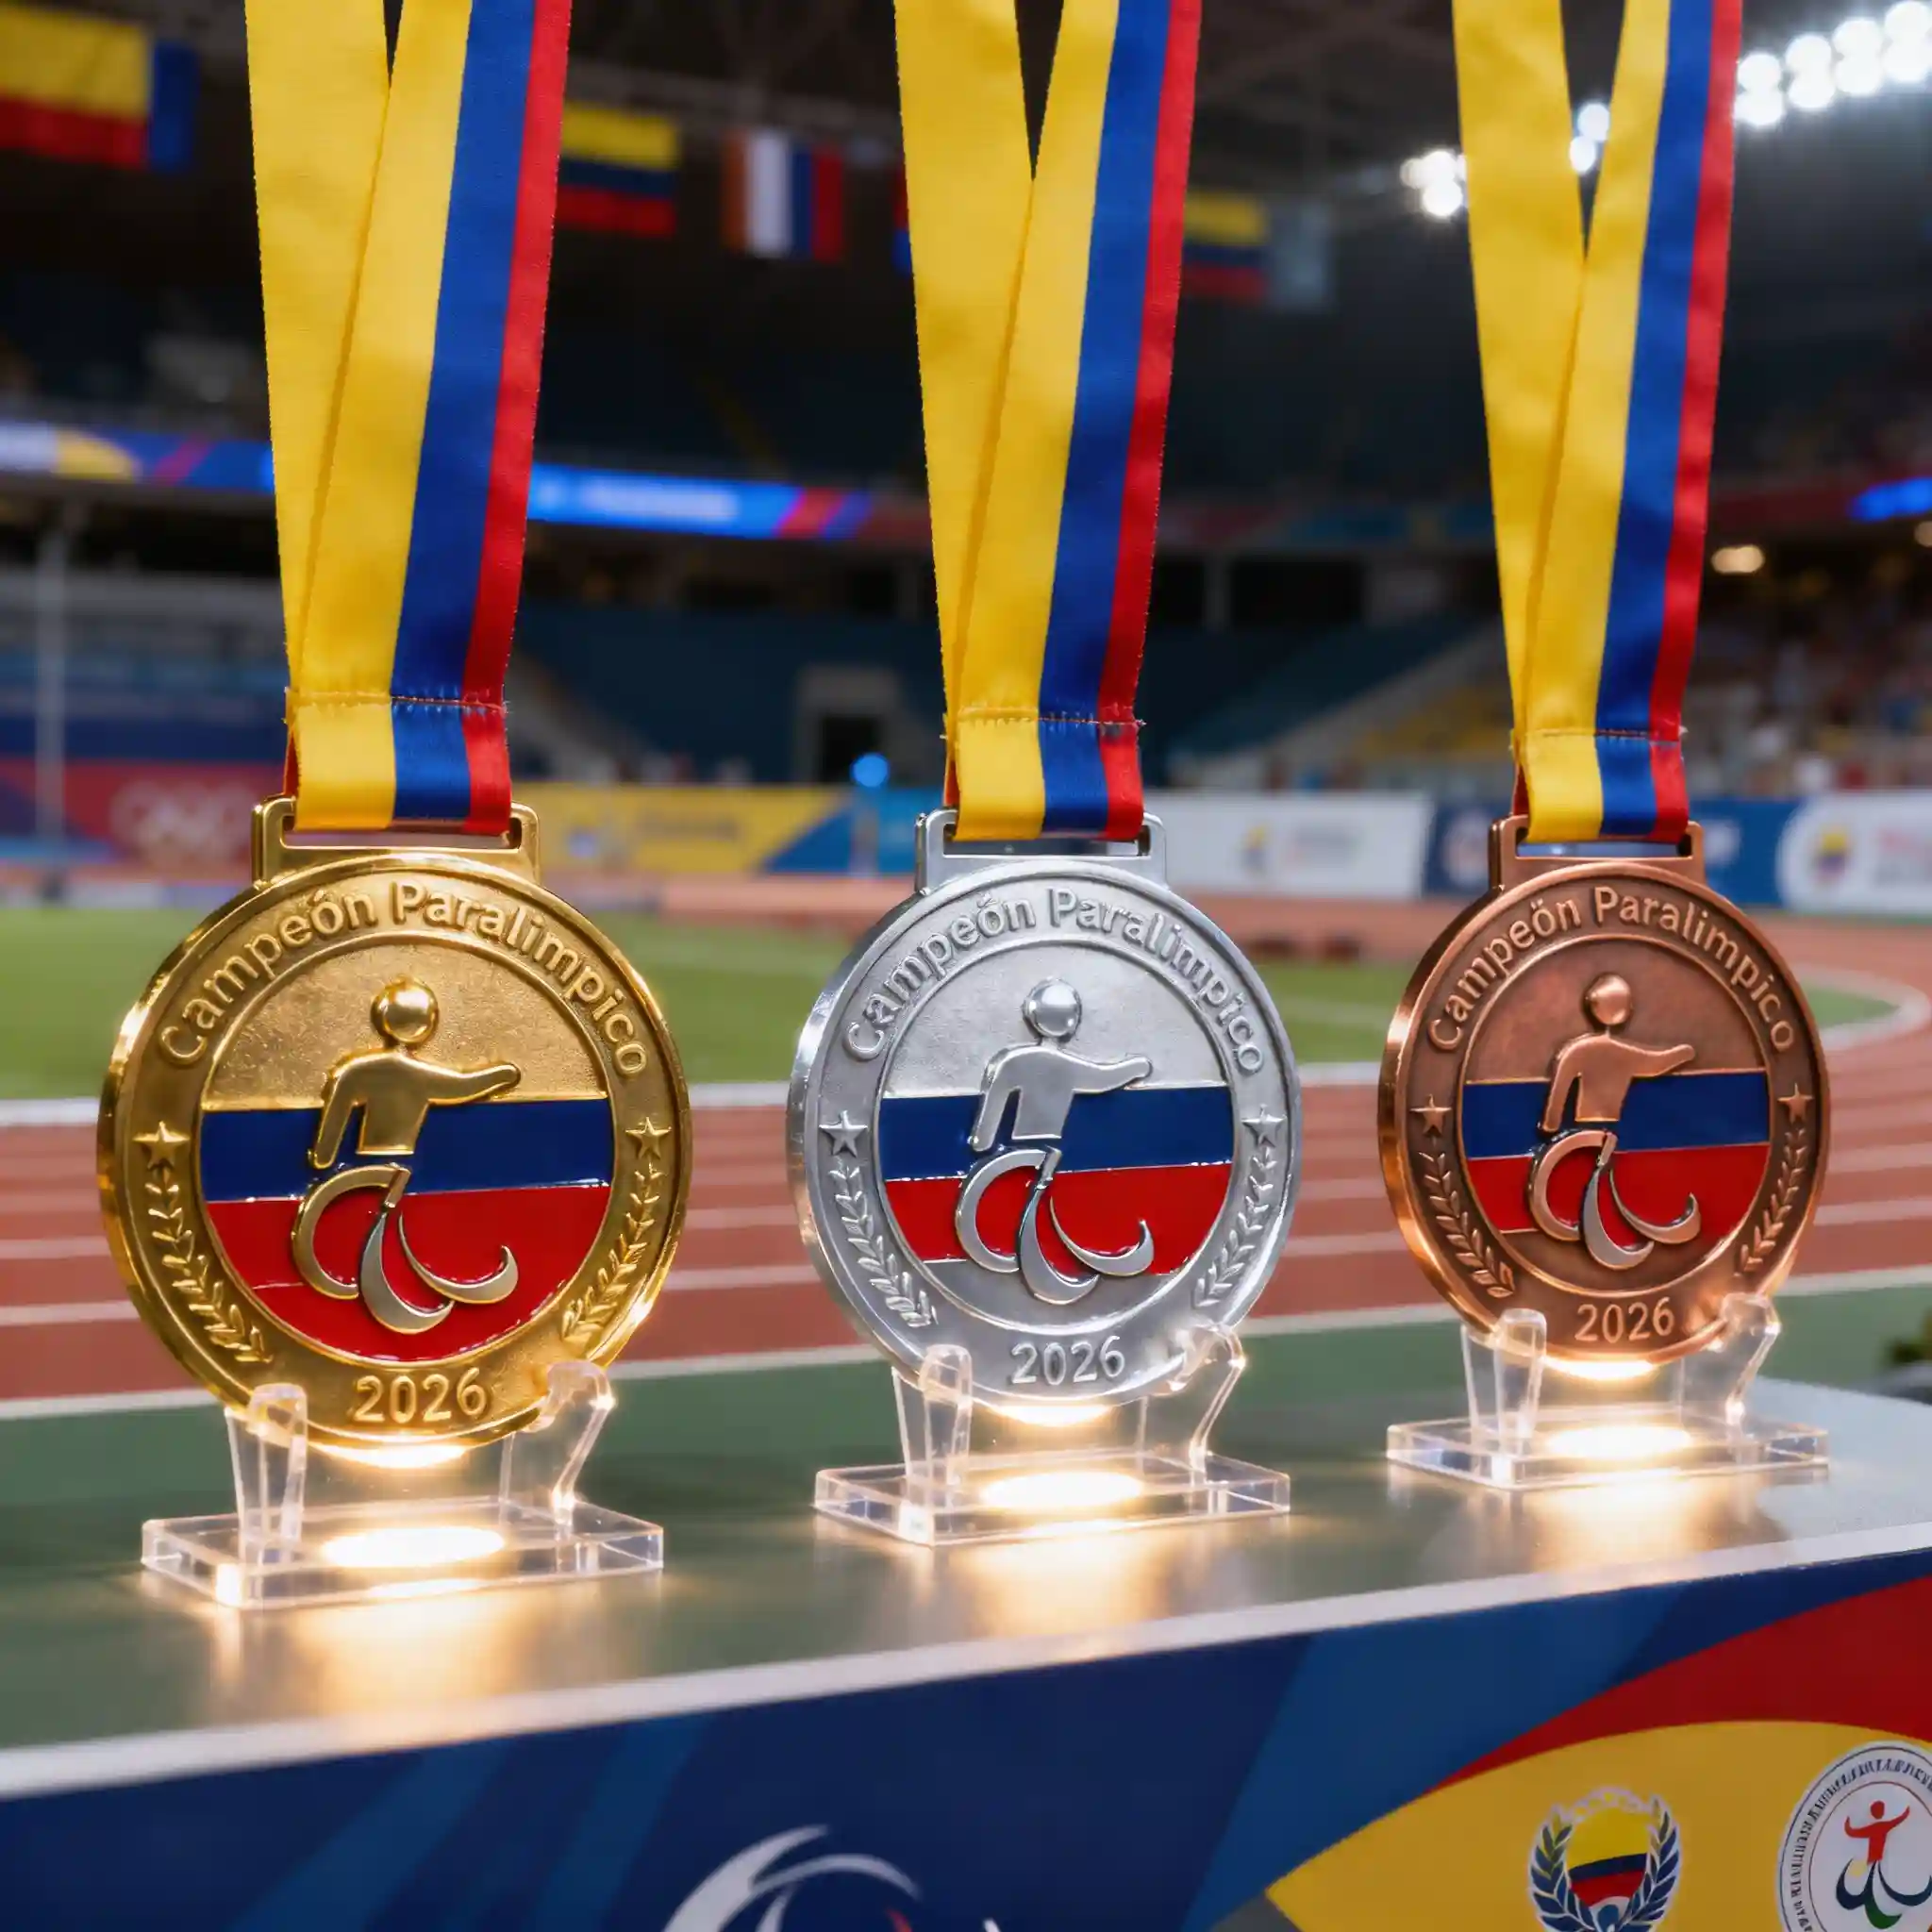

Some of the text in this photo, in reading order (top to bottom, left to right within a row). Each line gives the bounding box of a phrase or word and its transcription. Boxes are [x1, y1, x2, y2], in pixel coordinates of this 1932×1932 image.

[159, 889, 375, 1066] Campeón
[1574, 1298, 1676, 1343] 2026
[1009, 1336, 1126, 1387] 2026
[353, 1368, 488, 1424] 2026
